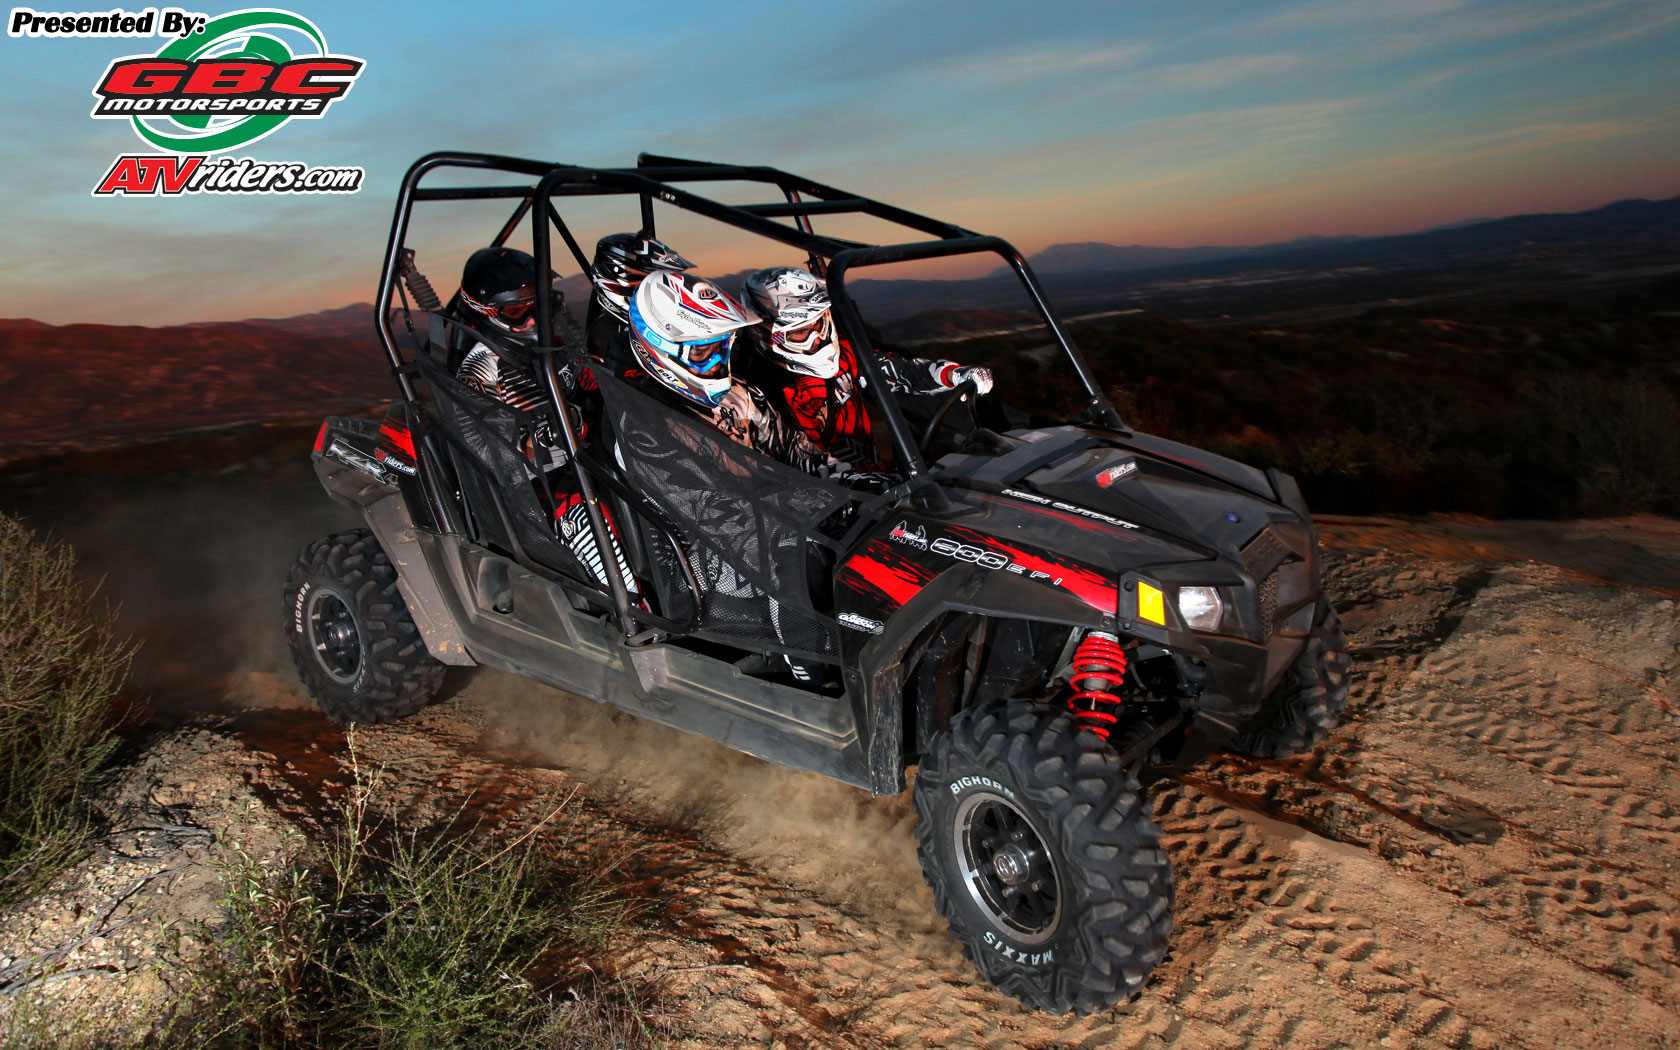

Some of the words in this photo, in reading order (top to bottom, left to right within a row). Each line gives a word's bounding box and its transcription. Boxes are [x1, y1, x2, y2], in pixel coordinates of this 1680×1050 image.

[657, 368, 680, 383] BOLT
[1052, 501, 1140, 529] OUTPUT
[930, 537, 1008, 570] 800
[295, 581, 311, 634] BIGHORN
[950, 775, 1015, 799] BIGHORN
[983, 930, 1053, 966] MAXXIS
